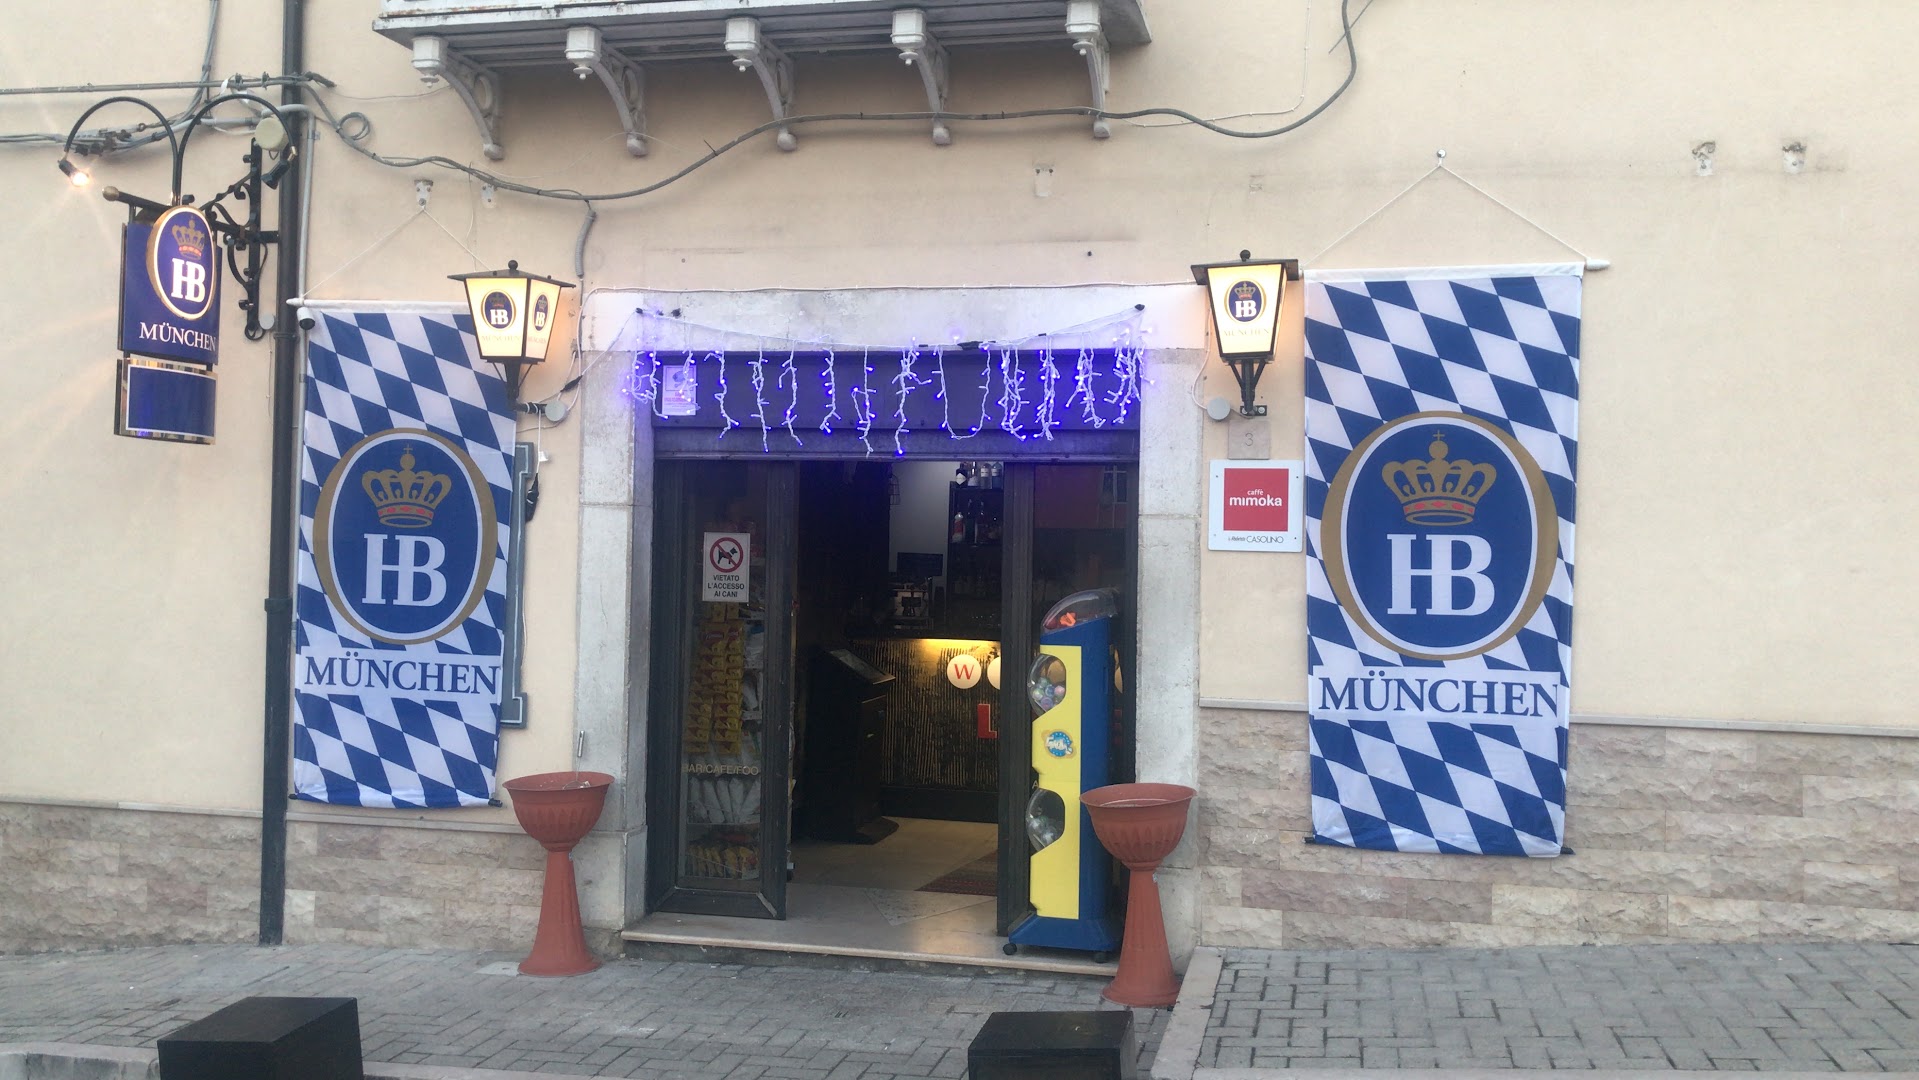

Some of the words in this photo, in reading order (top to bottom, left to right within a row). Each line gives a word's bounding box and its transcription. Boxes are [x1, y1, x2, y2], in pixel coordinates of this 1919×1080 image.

[171, 258, 206, 302] HB
[490, 309, 508, 324] HB
[1235, 300, 1257, 317] HB
[139, 322, 217, 351] MÜNCHEN
[1245, 433, 1254, 446] 3
[1229, 494, 1282, 507] mimoka
[362, 533, 447, 606] HB
[1387, 533, 1495, 616] HB
[304, 651, 499, 694] MÜNCHEN
[1318, 670, 1558, 717] MÜNCHEN
